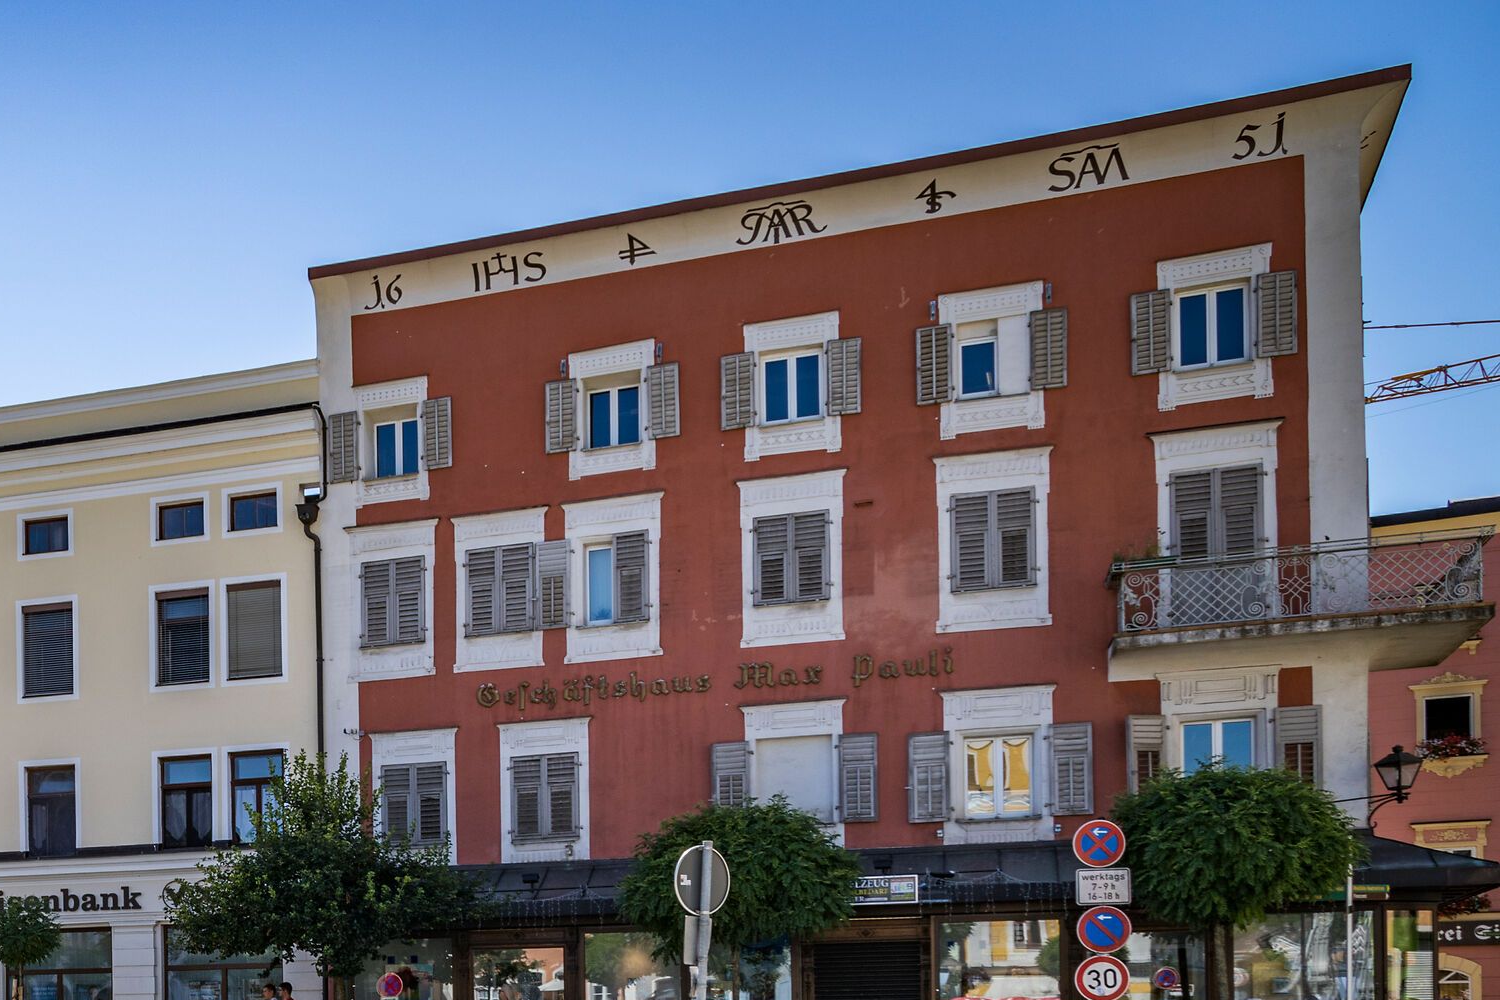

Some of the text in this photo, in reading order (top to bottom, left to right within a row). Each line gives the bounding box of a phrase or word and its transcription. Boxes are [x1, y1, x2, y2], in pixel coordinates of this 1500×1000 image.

[732, 659, 823, 690] Max
[850, 646, 955, 688] Pauli
[1081, 873, 1126, 882] werktags
[1086, 968, 1117, 990] 30
